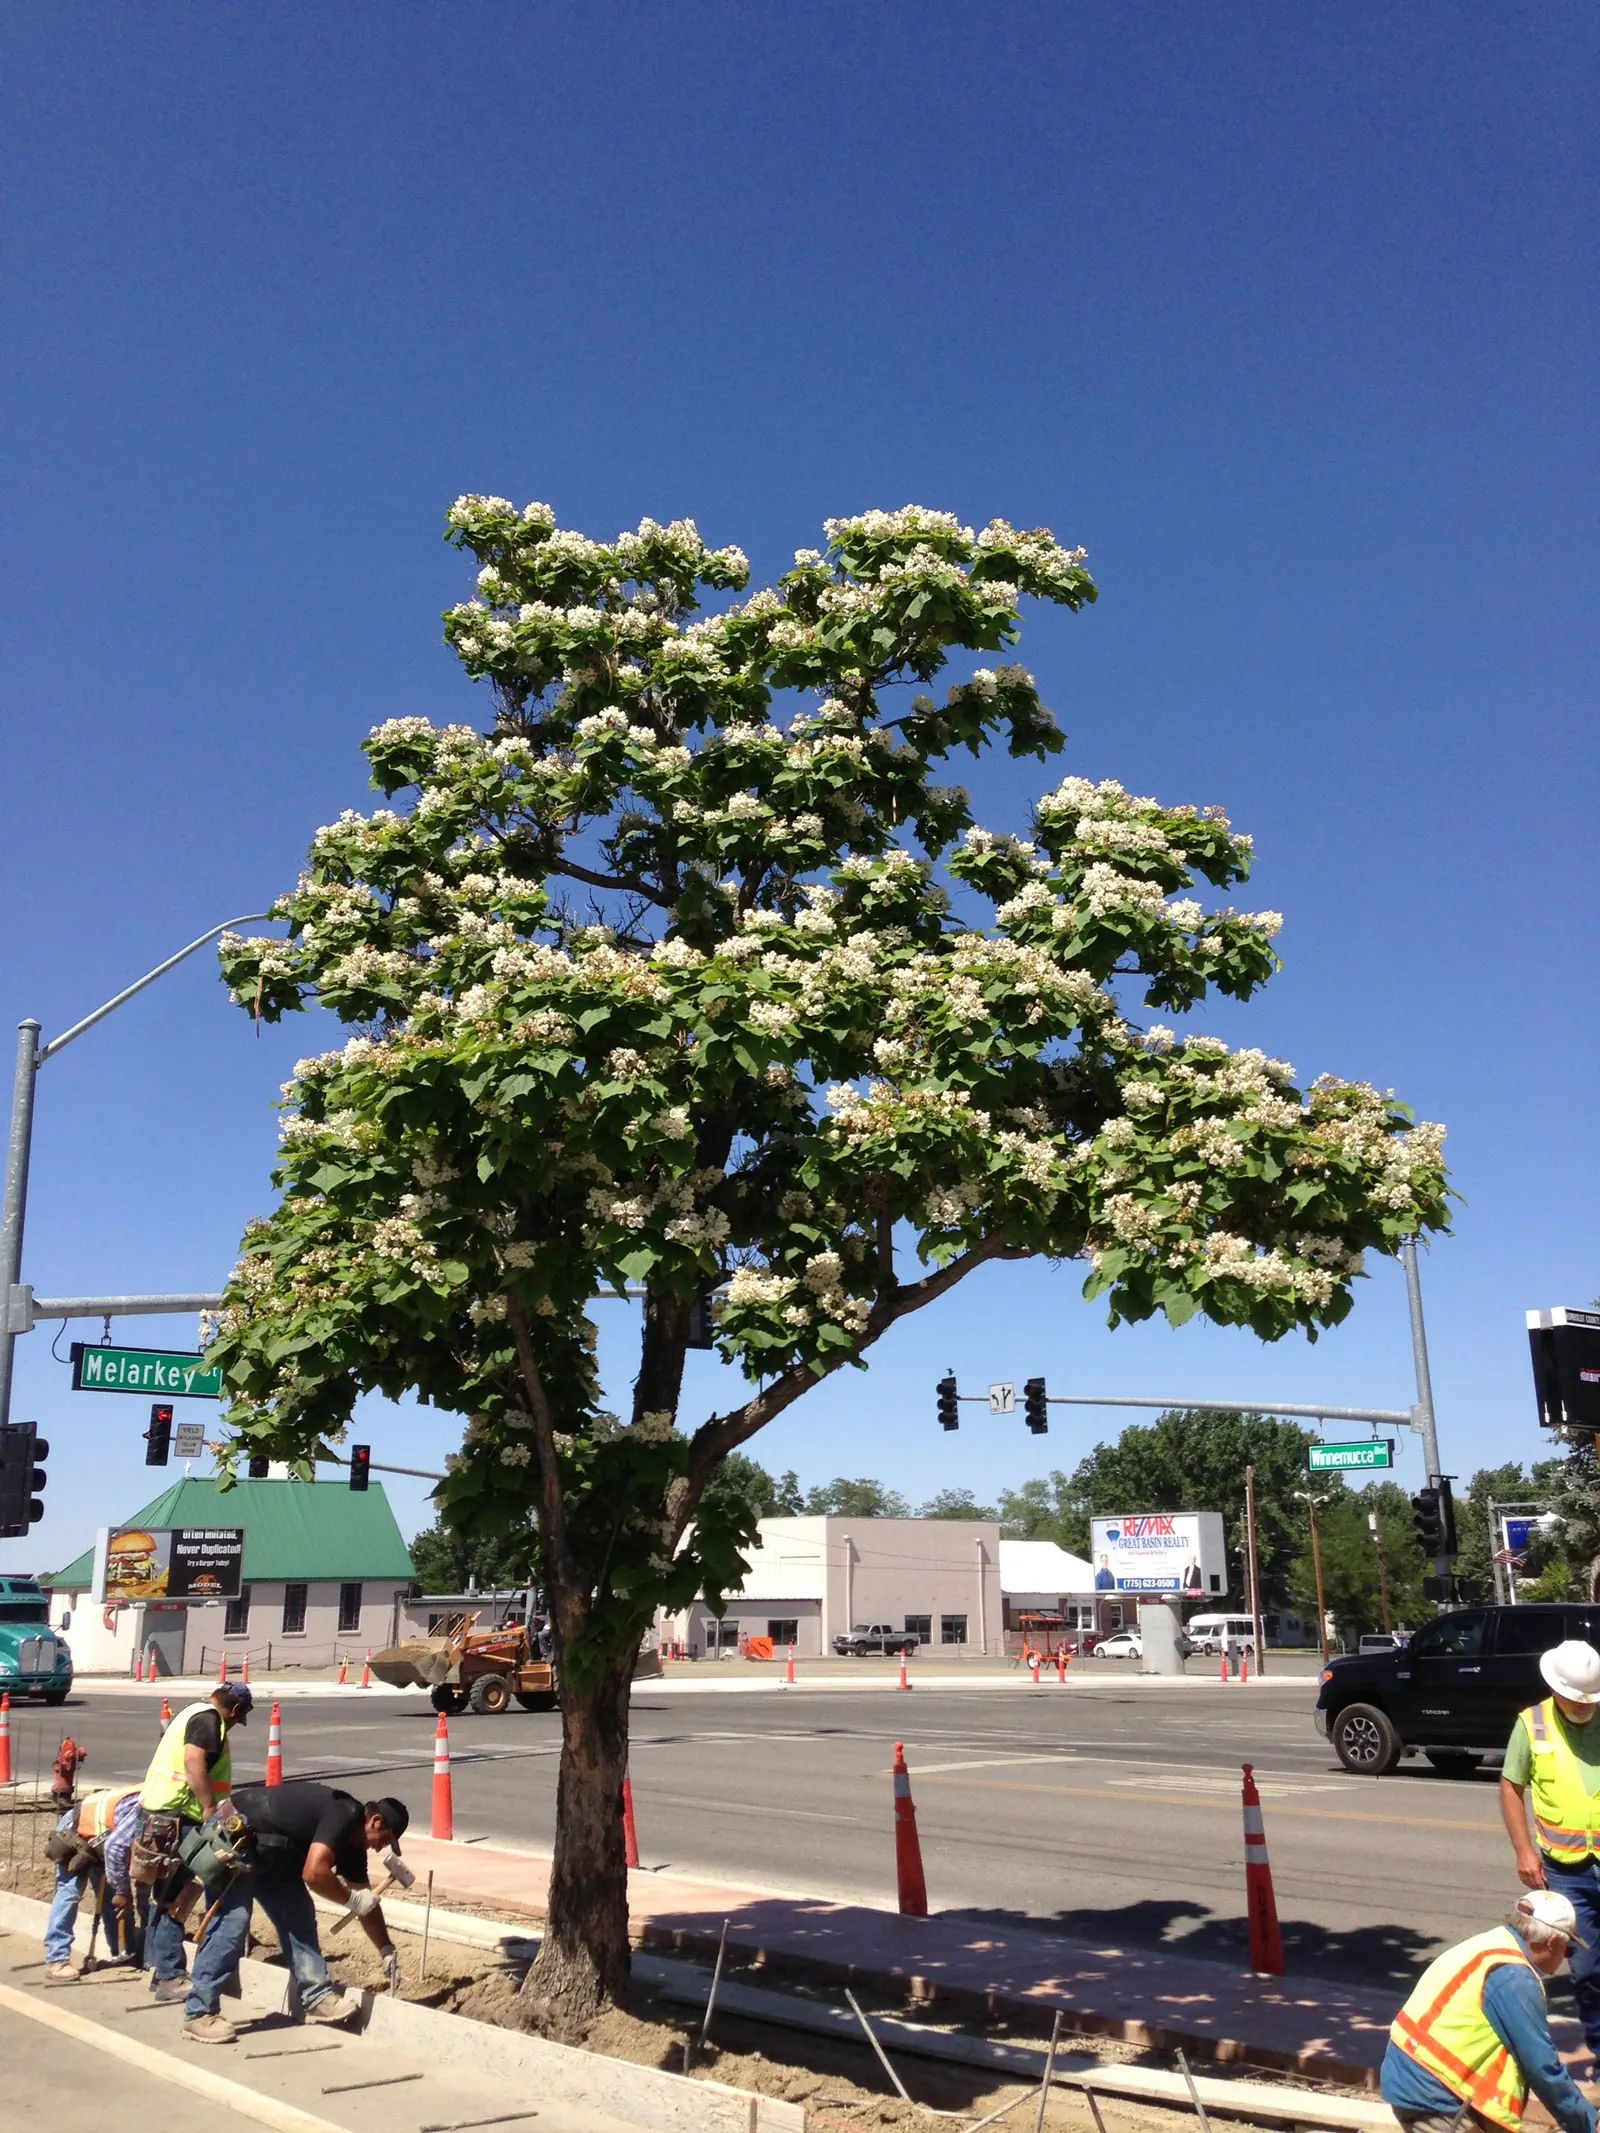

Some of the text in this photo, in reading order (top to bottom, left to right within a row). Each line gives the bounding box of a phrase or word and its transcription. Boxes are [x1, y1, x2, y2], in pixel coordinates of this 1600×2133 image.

[86, 1354, 196, 1392] Melarkey
[1311, 1446, 1386, 1466] Winnemucca Blvd
[1123, 1517, 1176, 1537] RE/MAX
[182, 1529, 204, 1539] Often
[177, 1544, 200, 1554] Never
[1118, 1536, 1190, 1549] GREAT BASIN REALTY
[1123, 1579, 1175, 1590] (775) 623-0500
